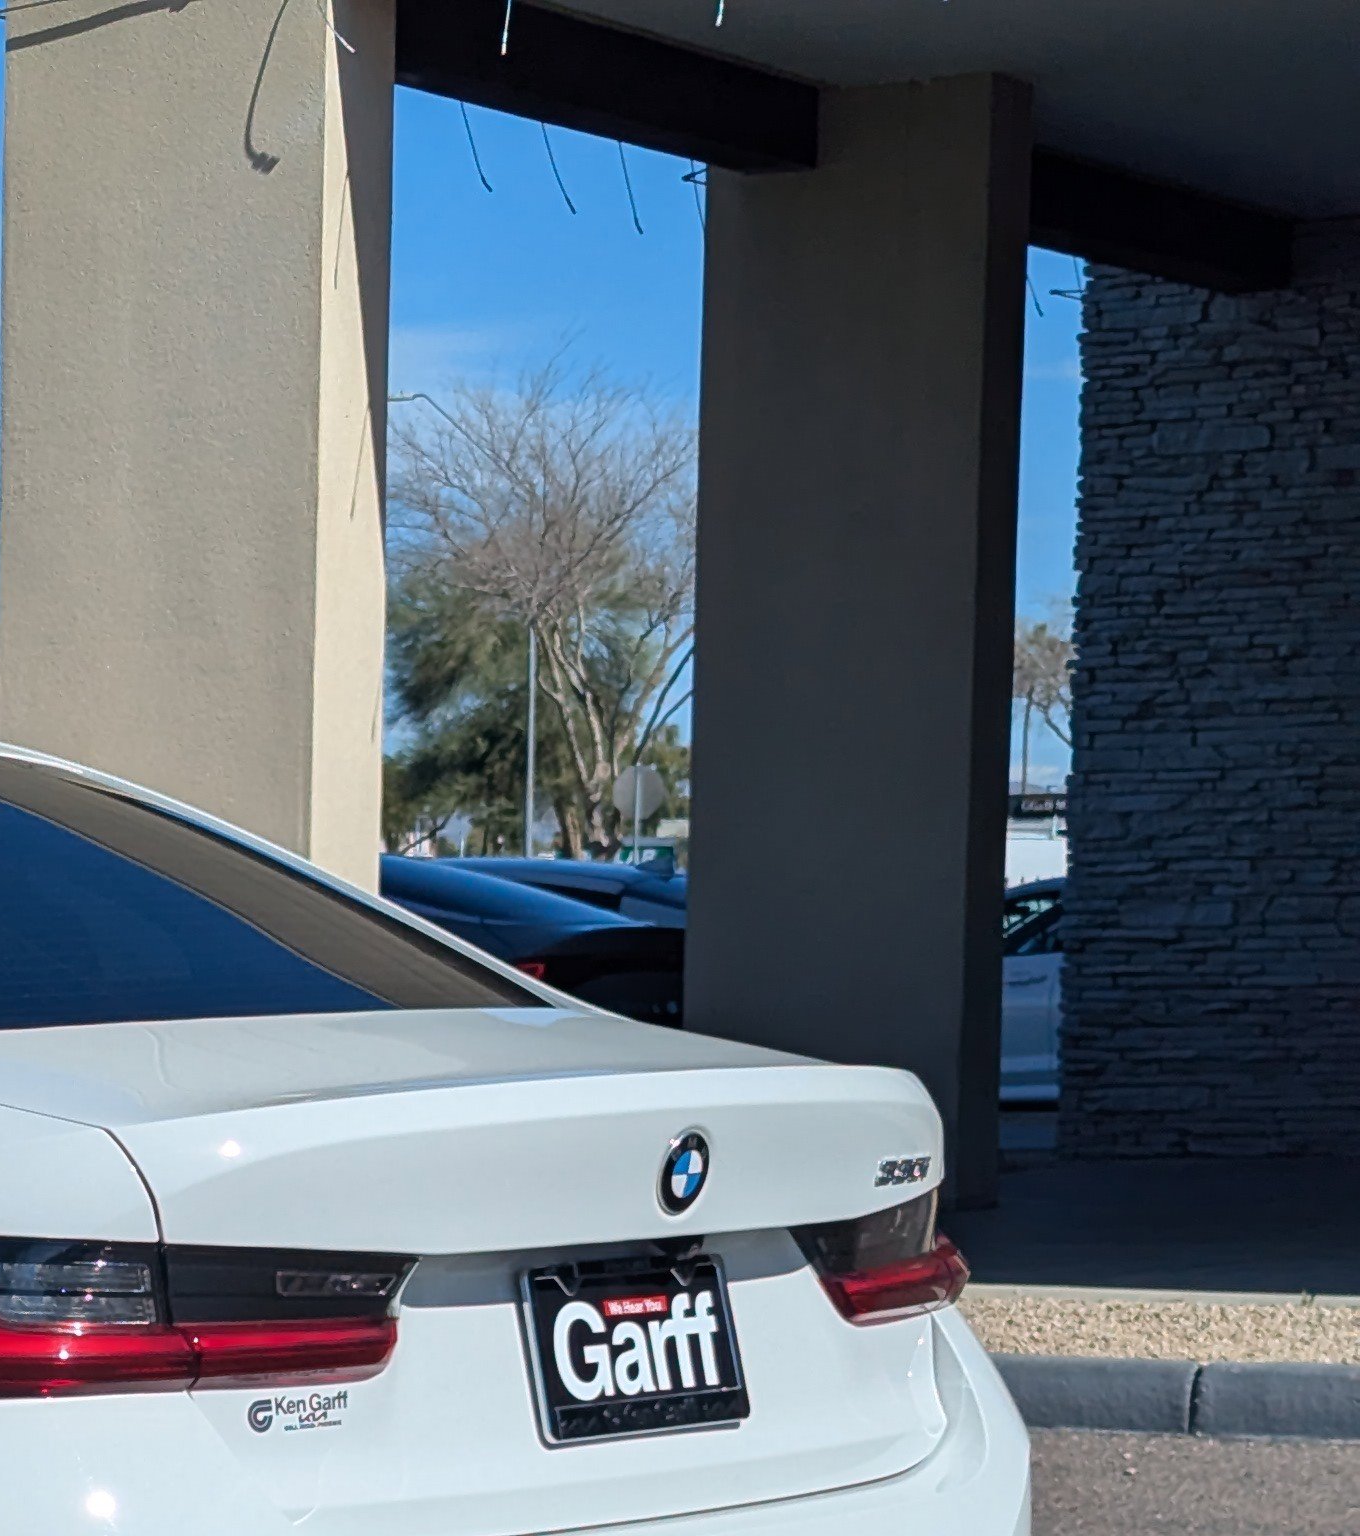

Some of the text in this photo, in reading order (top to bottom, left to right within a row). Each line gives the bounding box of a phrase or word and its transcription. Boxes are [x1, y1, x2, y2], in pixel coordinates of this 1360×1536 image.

[553, 1290, 720, 1401] Garff
[274, 1395, 307, 1416] Ken
[308, 1390, 348, 1412] Garff
